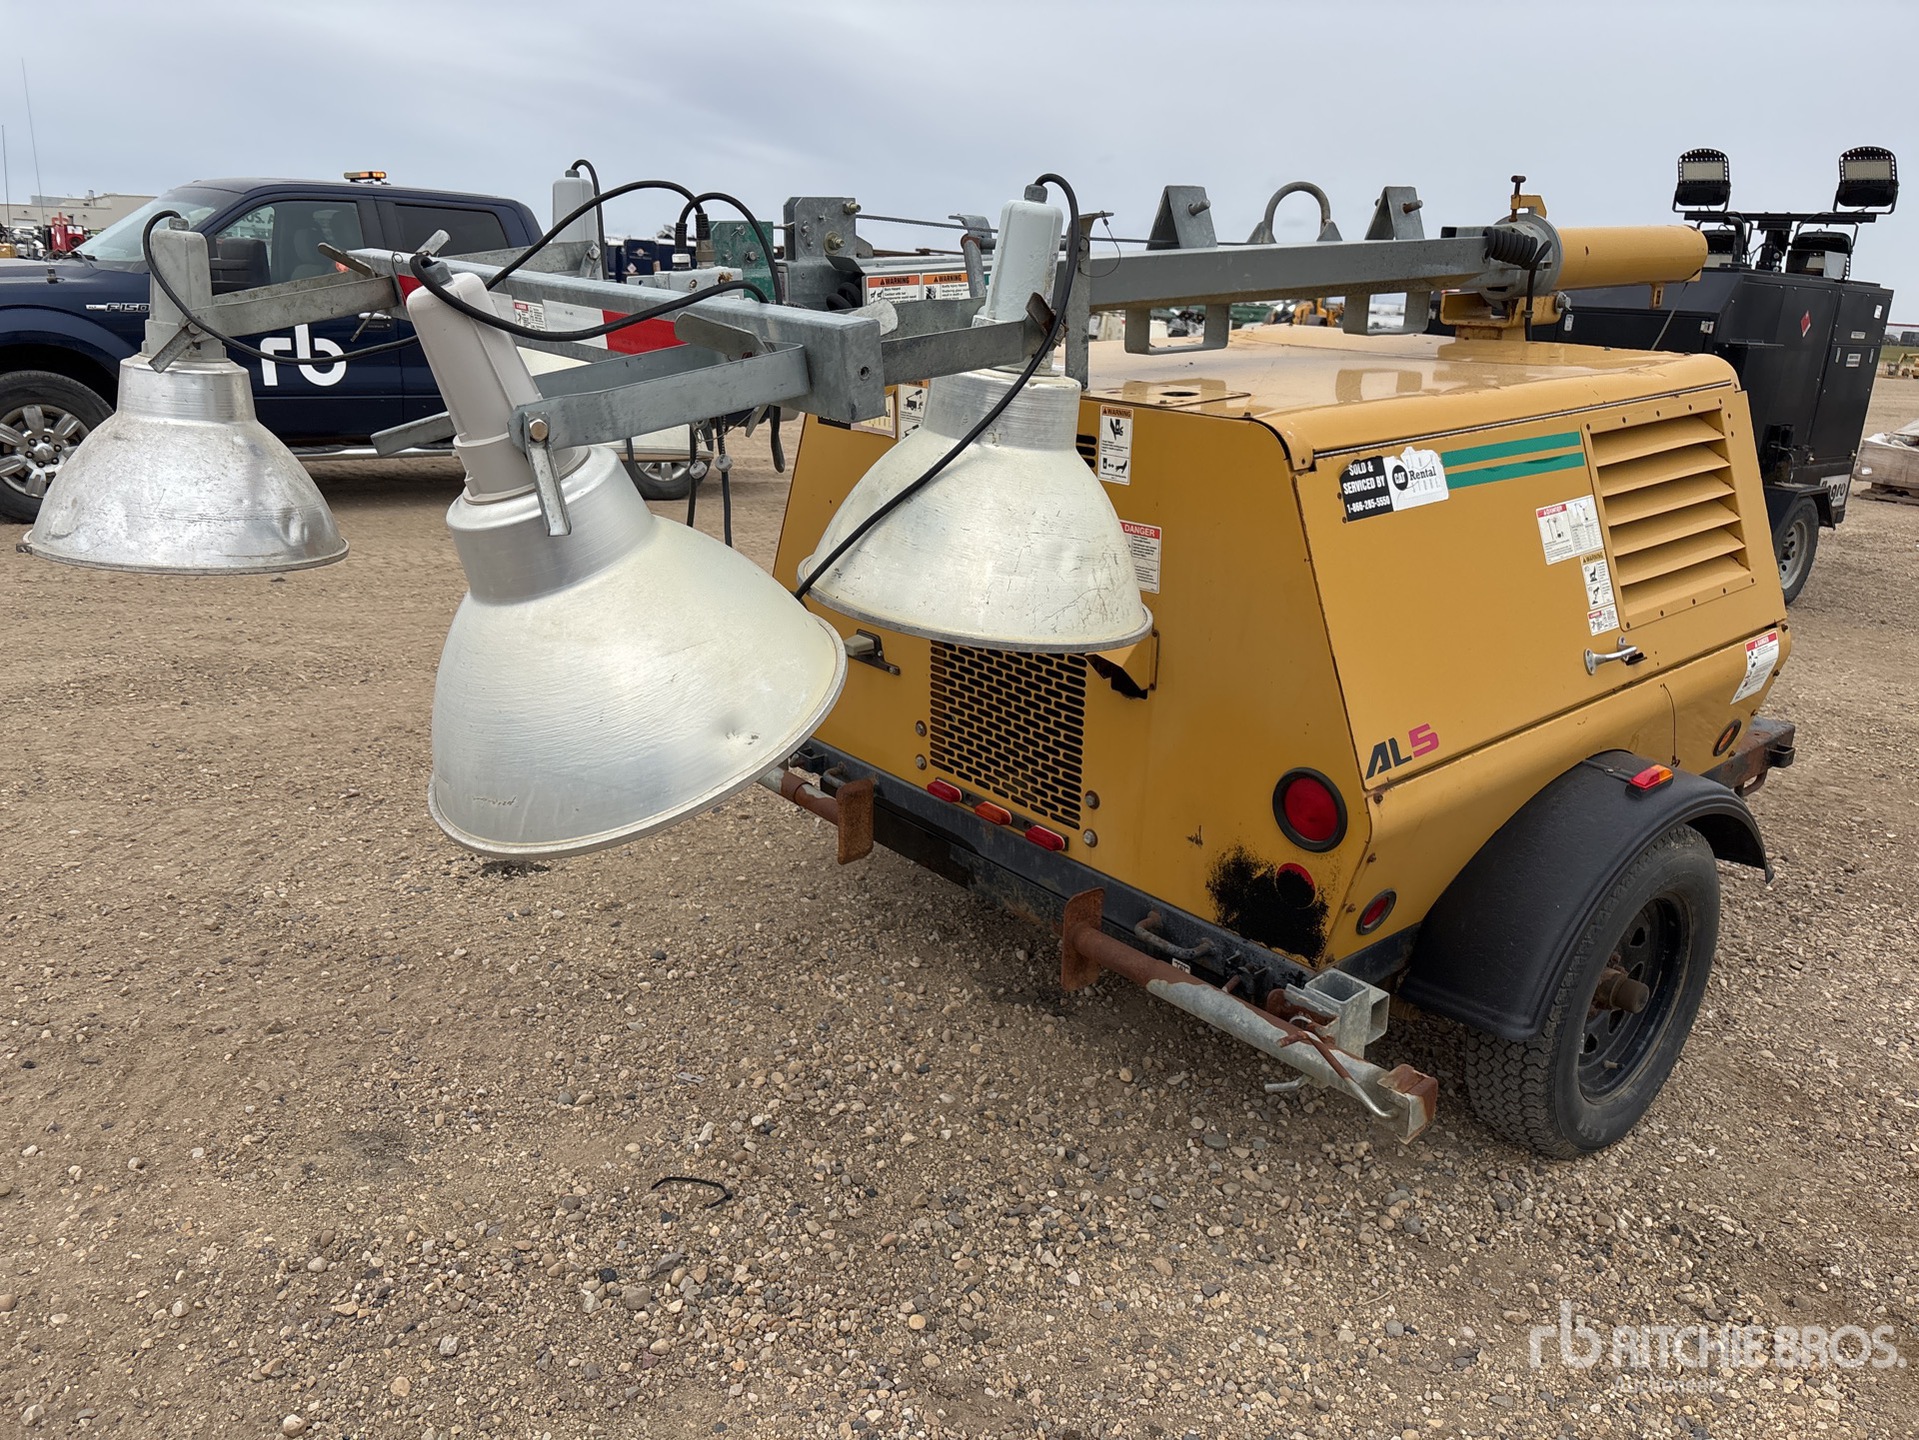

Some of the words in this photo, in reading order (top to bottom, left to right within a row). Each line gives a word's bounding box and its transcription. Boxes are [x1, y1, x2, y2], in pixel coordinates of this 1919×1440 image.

[261, 324, 346, 386] rb
[1108, 408, 1131, 418] WARNING
[1349, 462, 1368, 476] SOLD
[1367, 461, 1374, 473] &
[1409, 466, 1436, 481] Rental
[1343, 477, 1375, 495] SERVICED
[1376, 475, 1386, 488] BY
[1393, 472, 1406, 484] CAT
[1125, 524, 1155, 537] DANGER
